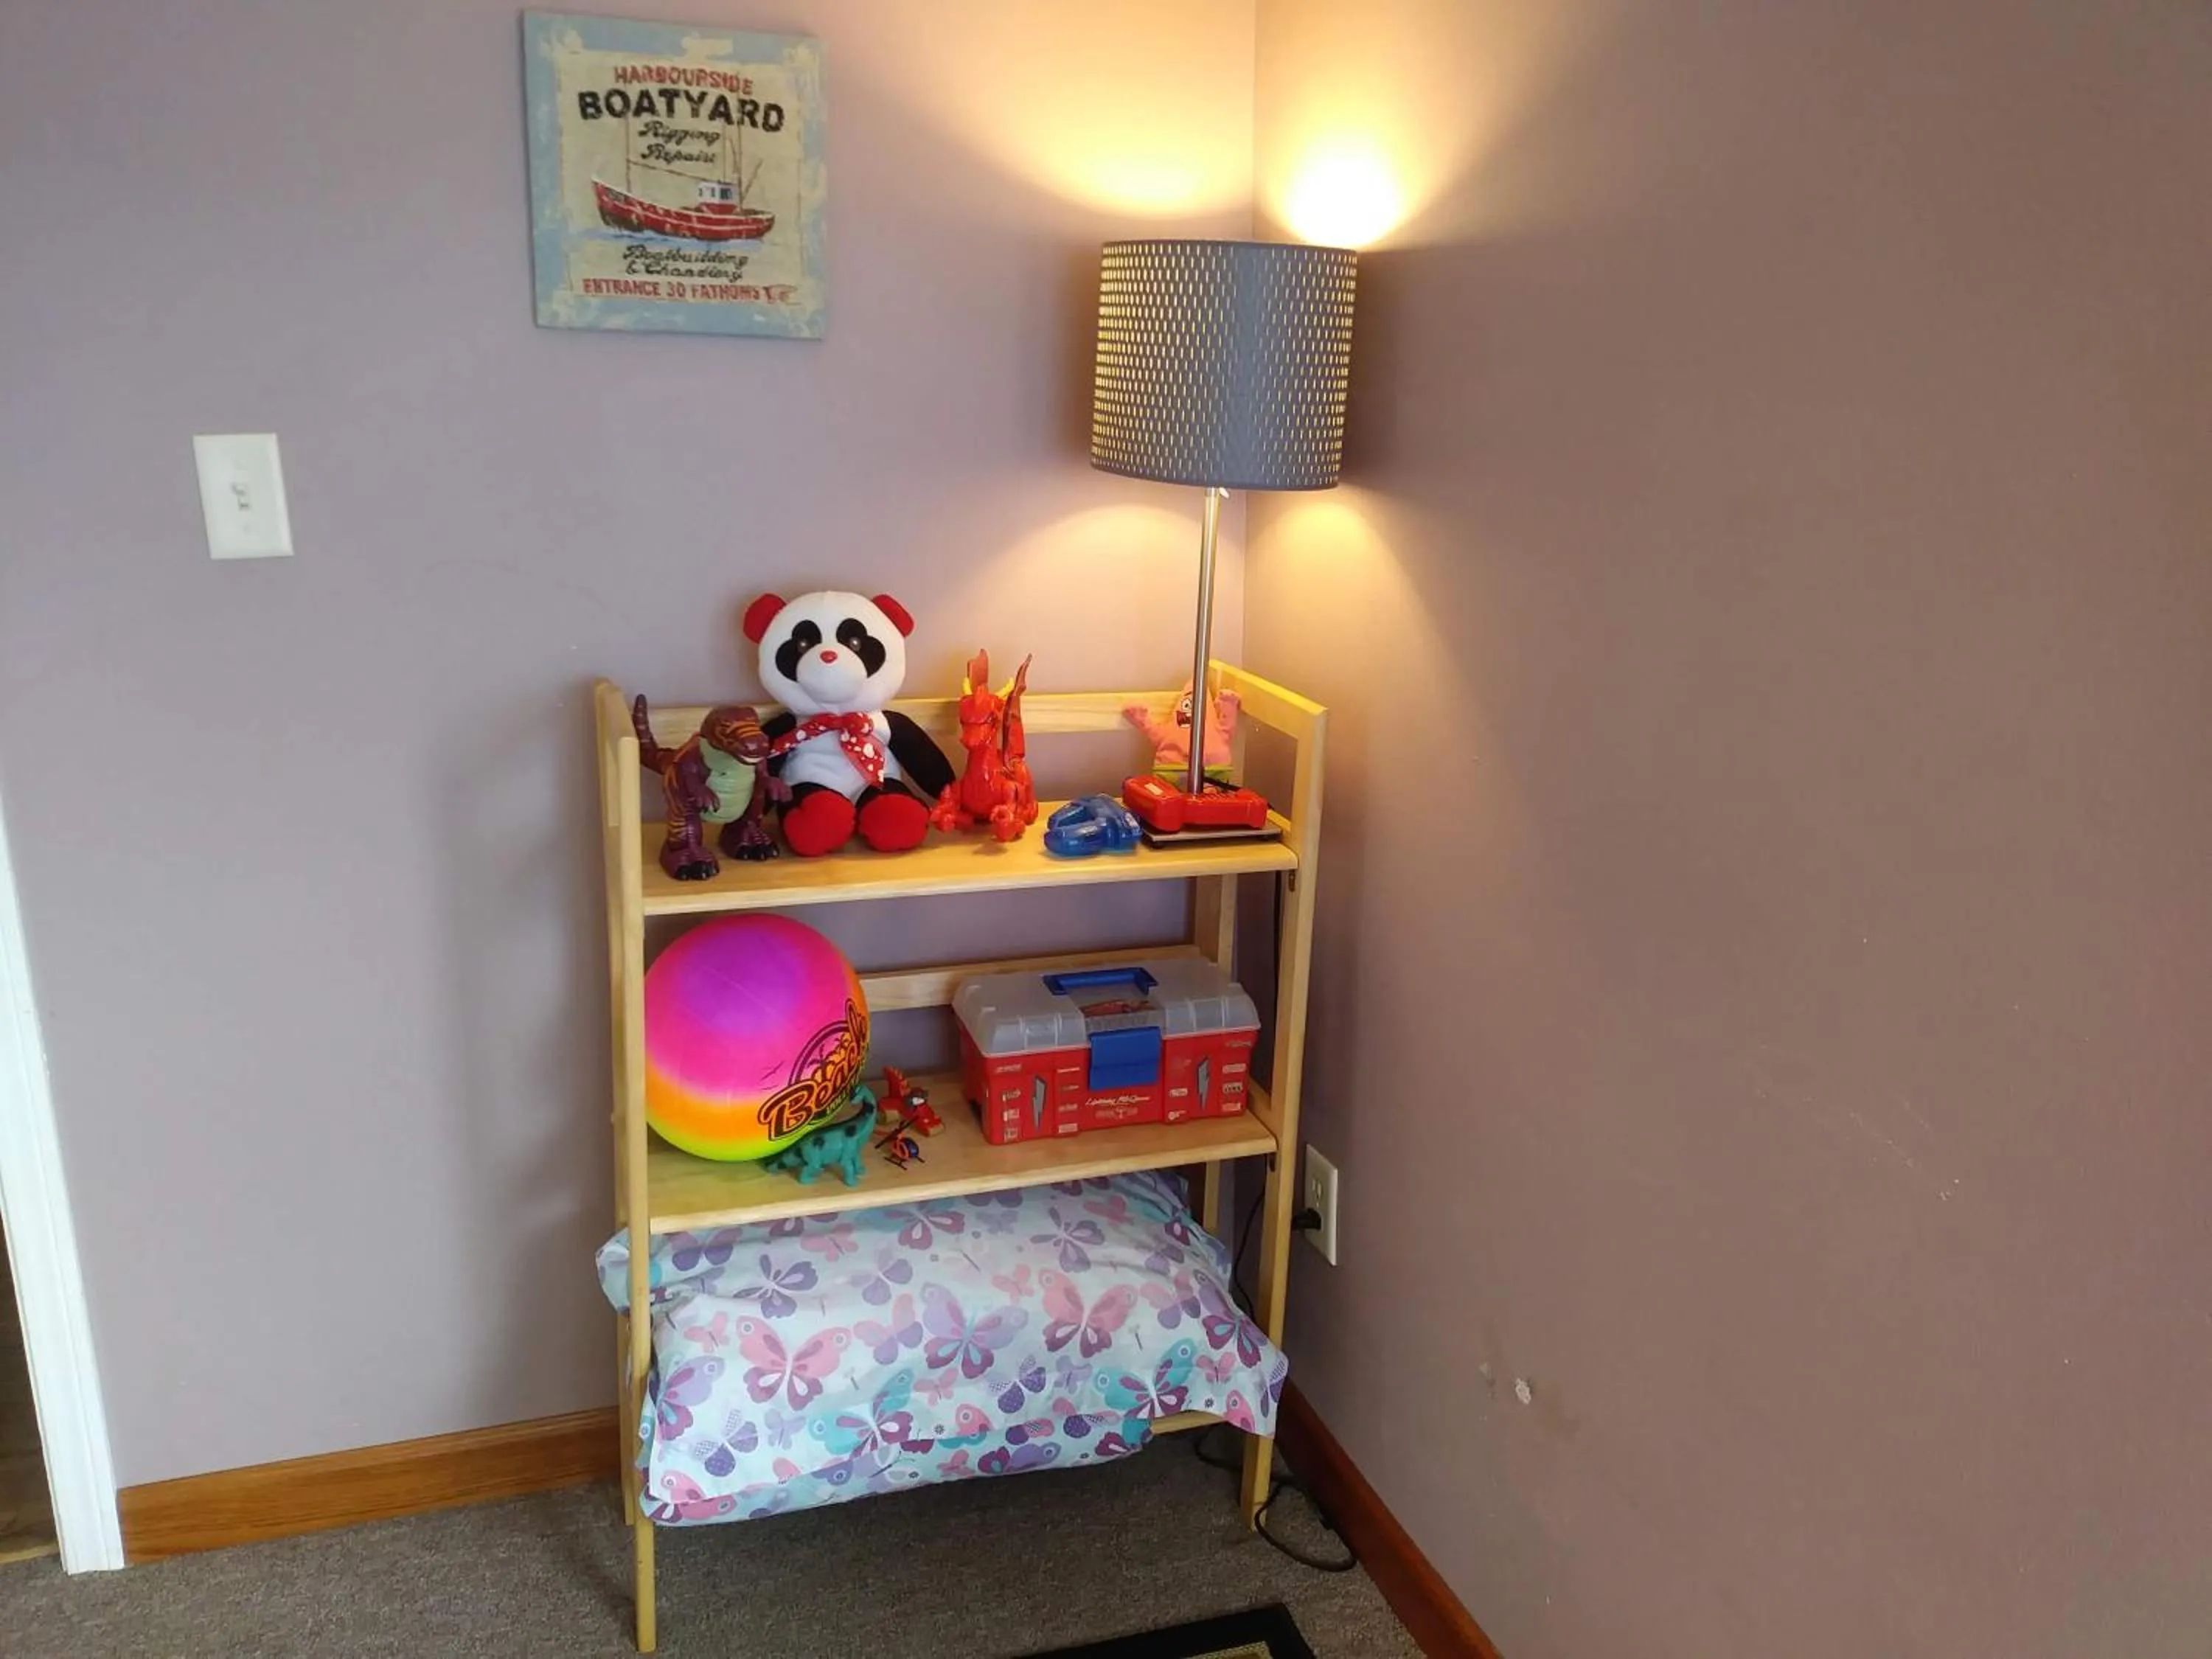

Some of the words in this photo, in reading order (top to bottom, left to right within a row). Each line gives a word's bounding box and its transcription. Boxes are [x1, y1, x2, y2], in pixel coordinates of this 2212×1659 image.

[614, 65, 754, 95] HARBOURSIDE
[578, 88, 785, 132] BOATYARD
[582, 278, 661, 296] ENTRANCE
[667, 281, 686, 298] 30
[757, 998, 867, 1141] Beach
